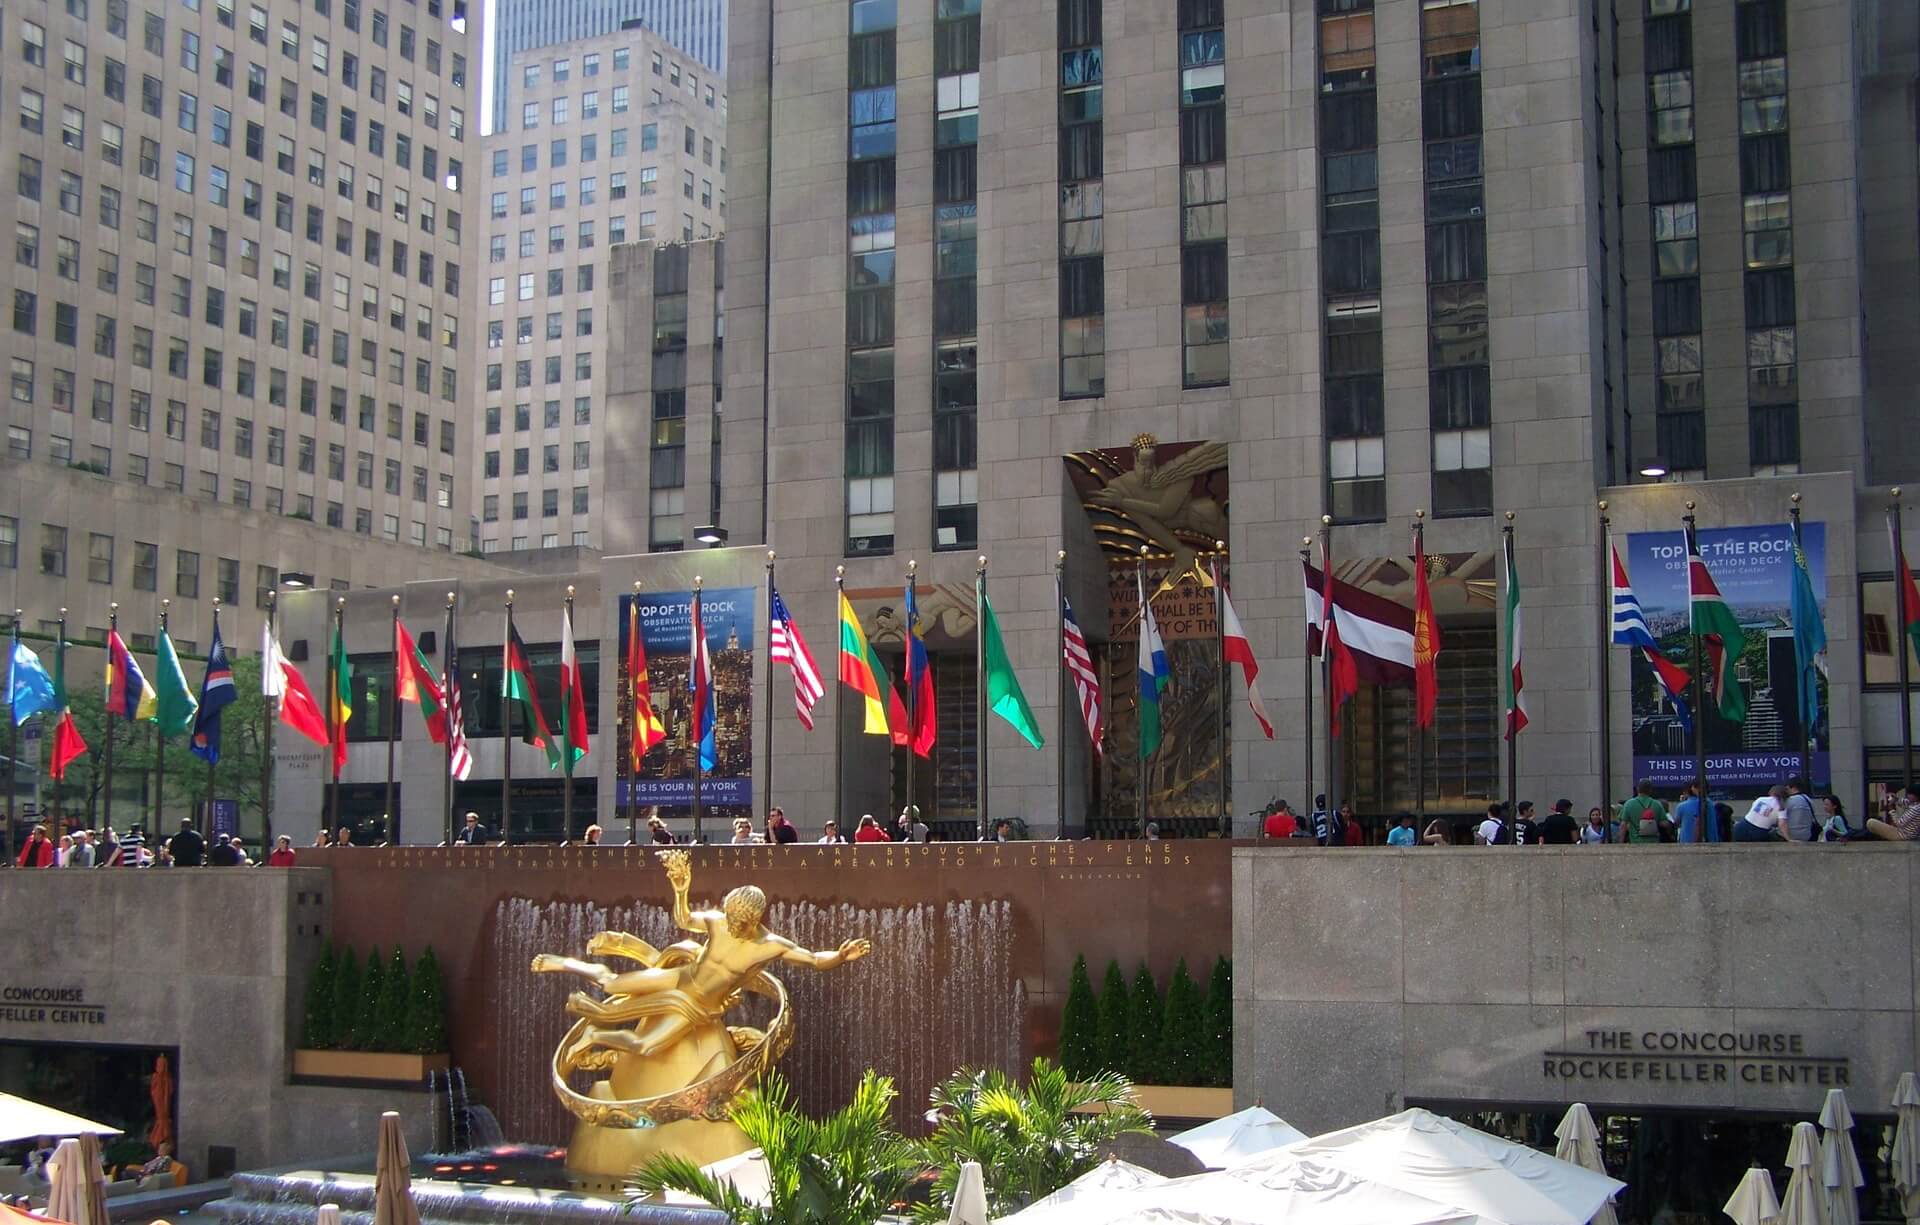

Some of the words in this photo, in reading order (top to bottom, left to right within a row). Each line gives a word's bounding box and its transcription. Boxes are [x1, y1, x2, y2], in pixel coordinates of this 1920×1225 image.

[1650, 545, 1684, 559] TOP
[1712, 541, 1745, 555] THE
[1665, 557, 1746, 570] OBSVATION
[1751, 555, 1782, 565] DECK
[639, 605, 658, 618] OP
[659, 604, 675, 616] OF
[676, 602, 692, 615] TH
[701, 600, 736, 613] ROCK
[643, 615, 694, 627] OBSERVATIO
[1174, 620, 1193, 634] OF
[1648, 759, 1677, 770] THIS
[1681, 759, 1693, 769] IS
[1703, 758, 1733, 769] OUR
[1736, 757, 1768, 768] NEW
[1772, 756, 1800, 767] YOR
[648, 783, 657, 792] IS
[660, 782, 685, 792] YOUR
[687, 782, 709, 791] NW
[711, 781, 737, 791] YORK
[1515, 831, 1525, 845] 5
[718, 846, 791, 857] EVERY
[817, 846, 859, 857] ART
[1031, 844, 1075, 855] THE
[1106, 843, 1170, 854] FIRE
[833, 857, 911, 867] MEANS
[940, 857, 966, 867] TO
[993, 856, 1095, 866] MIGHTY
[1125, 855, 1192, 866] ENDS
[3, 986, 84, 1002] CONCOURSE
[52, 1010, 105, 1024] CENTER
[1586, 1031, 1632, 1049] THE
[1641, 1031, 1803, 1053] CONCOURSE
[1543, 1060, 1728, 1083] ROCKEFELLER
[1741, 1063, 1849, 1085] CENTER
